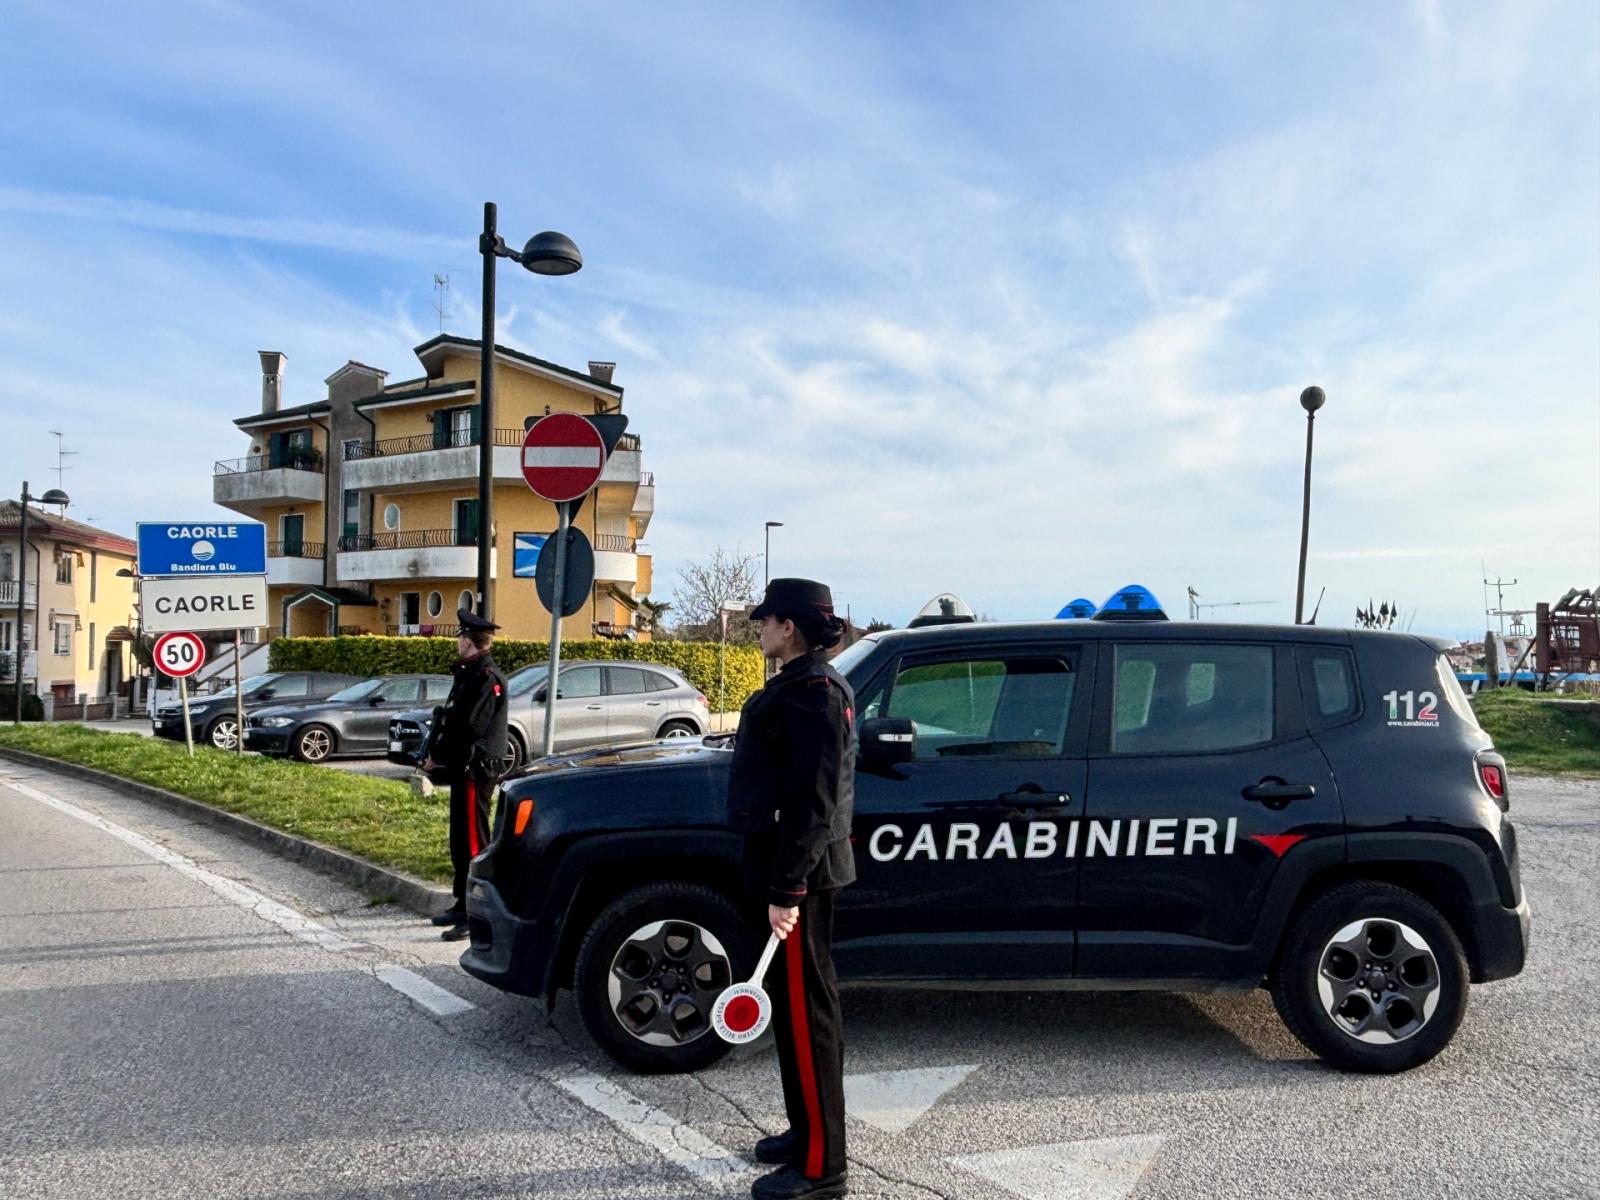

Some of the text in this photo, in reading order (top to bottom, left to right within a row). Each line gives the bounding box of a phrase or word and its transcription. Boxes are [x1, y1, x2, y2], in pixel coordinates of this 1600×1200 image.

[167, 526, 238, 539] CAORLE
[171, 562, 237, 571] Bandiera Blu
[155, 594, 255, 613] CAORLE
[166, 643, 194, 665] 50
[1383, 690, 1438, 720] 112
[868, 817, 1238, 862] CARABINIERI
